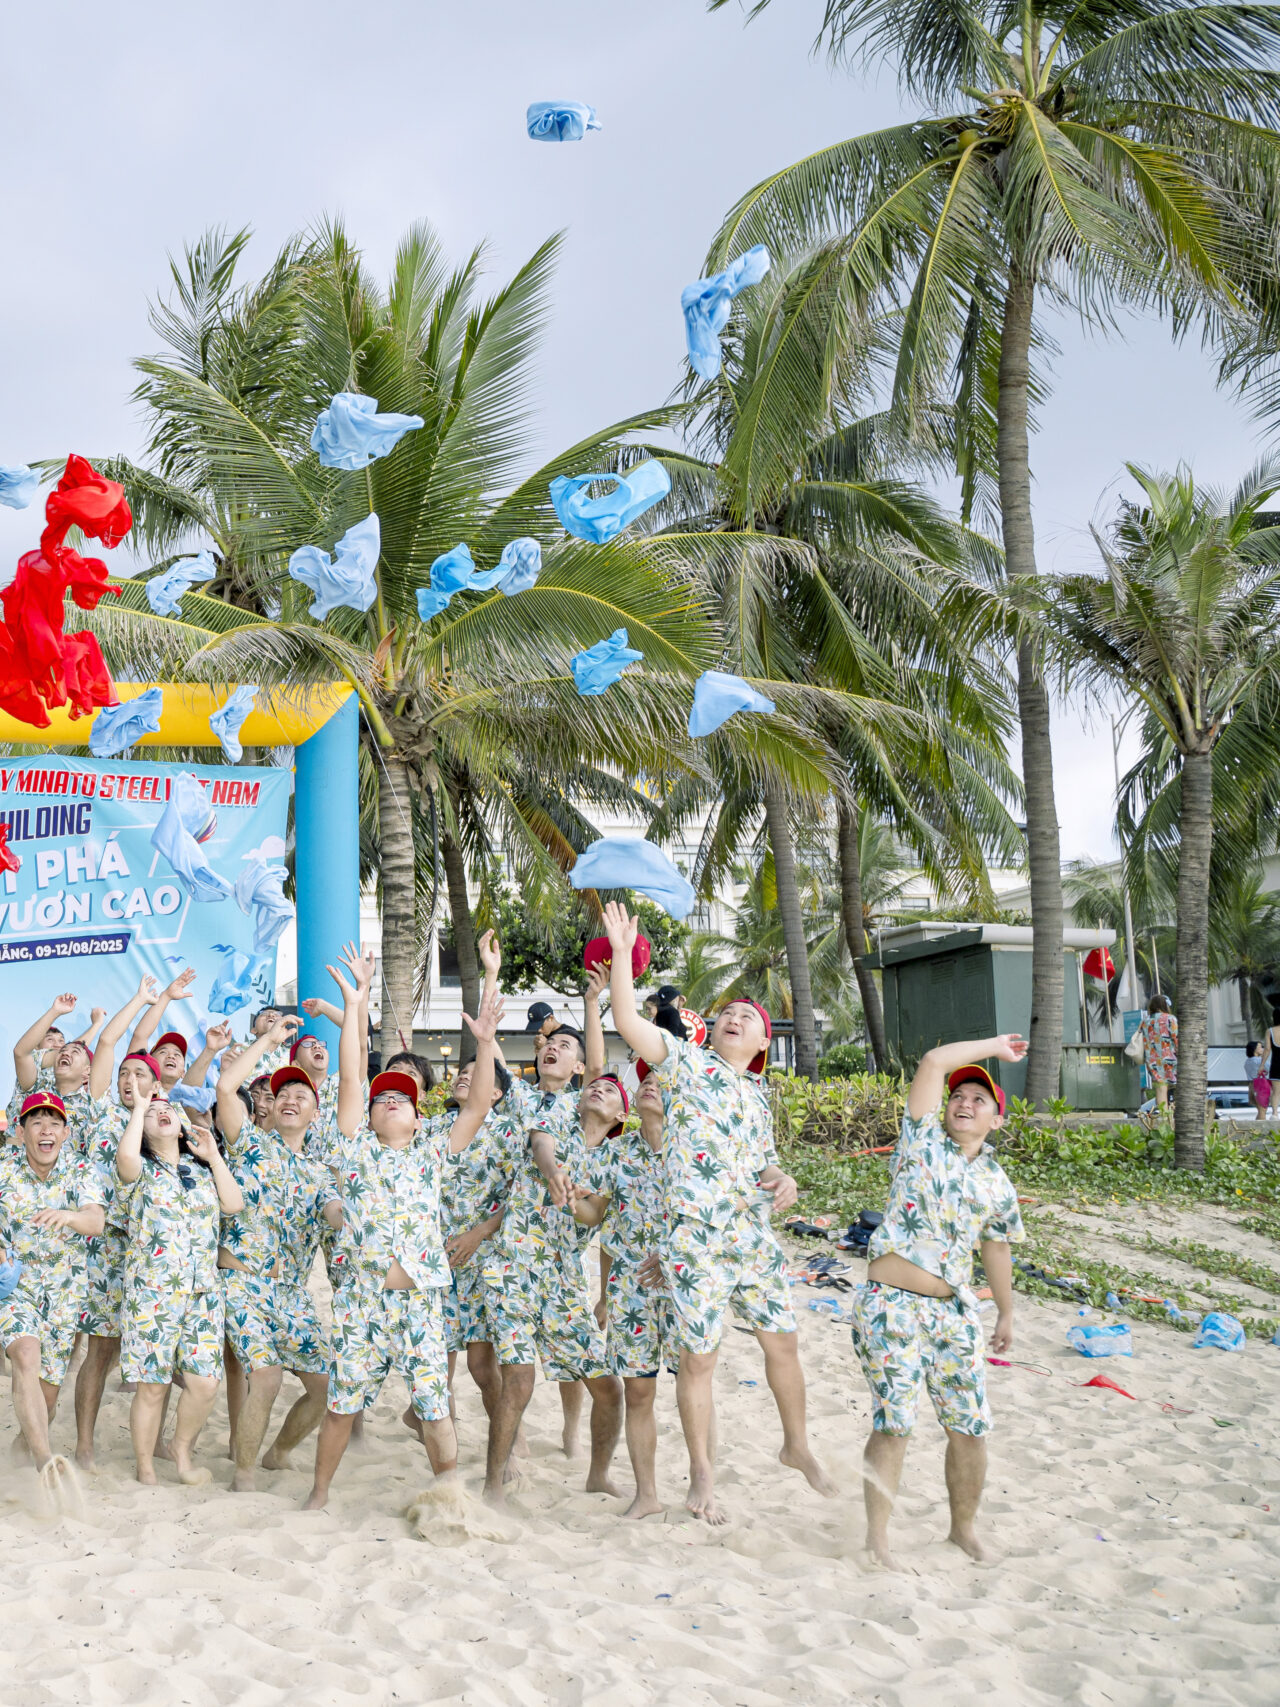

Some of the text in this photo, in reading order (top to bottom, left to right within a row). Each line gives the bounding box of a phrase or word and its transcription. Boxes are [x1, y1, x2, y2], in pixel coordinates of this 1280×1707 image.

[15, 768, 97, 797] MINATO
[99, 774, 161, 801] STEEL
[211, 779, 261, 807] NAM
[36, 831, 130, 888] PHÁ
[102, 885, 181, 919] CAO
[35, 939, 123, 957] 09-12/08/2025
[680, 1010, 704, 1030] ANDS
